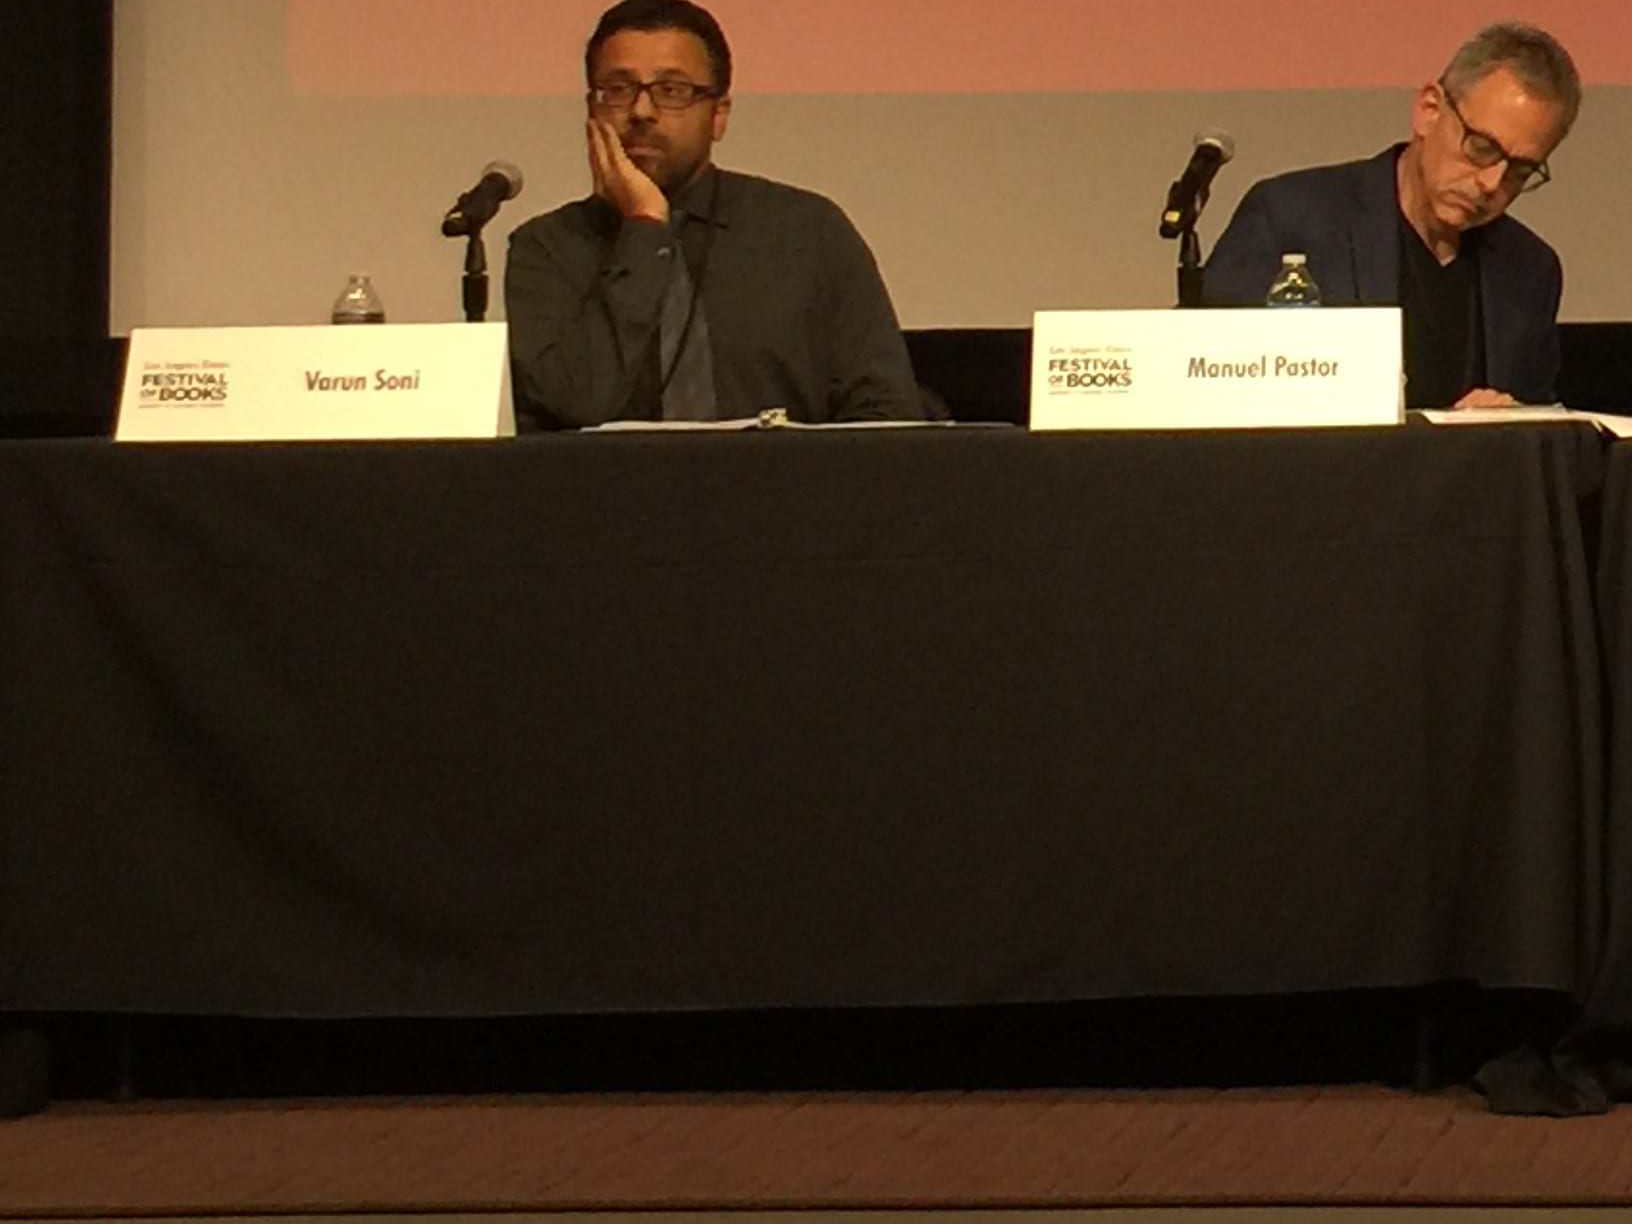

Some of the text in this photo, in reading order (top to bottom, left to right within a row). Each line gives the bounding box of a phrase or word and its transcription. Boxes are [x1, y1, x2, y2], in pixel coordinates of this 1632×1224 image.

[1049, 358, 1132, 372] FESTIVAL
[1188, 355, 1339, 378] Manuel Pastor
[141, 373, 228, 387] FESTIVAL
[305, 369, 420, 392] Varun Soni
[1067, 373, 1132, 388] BOOKS
[159, 387, 227, 401] BOOKS
